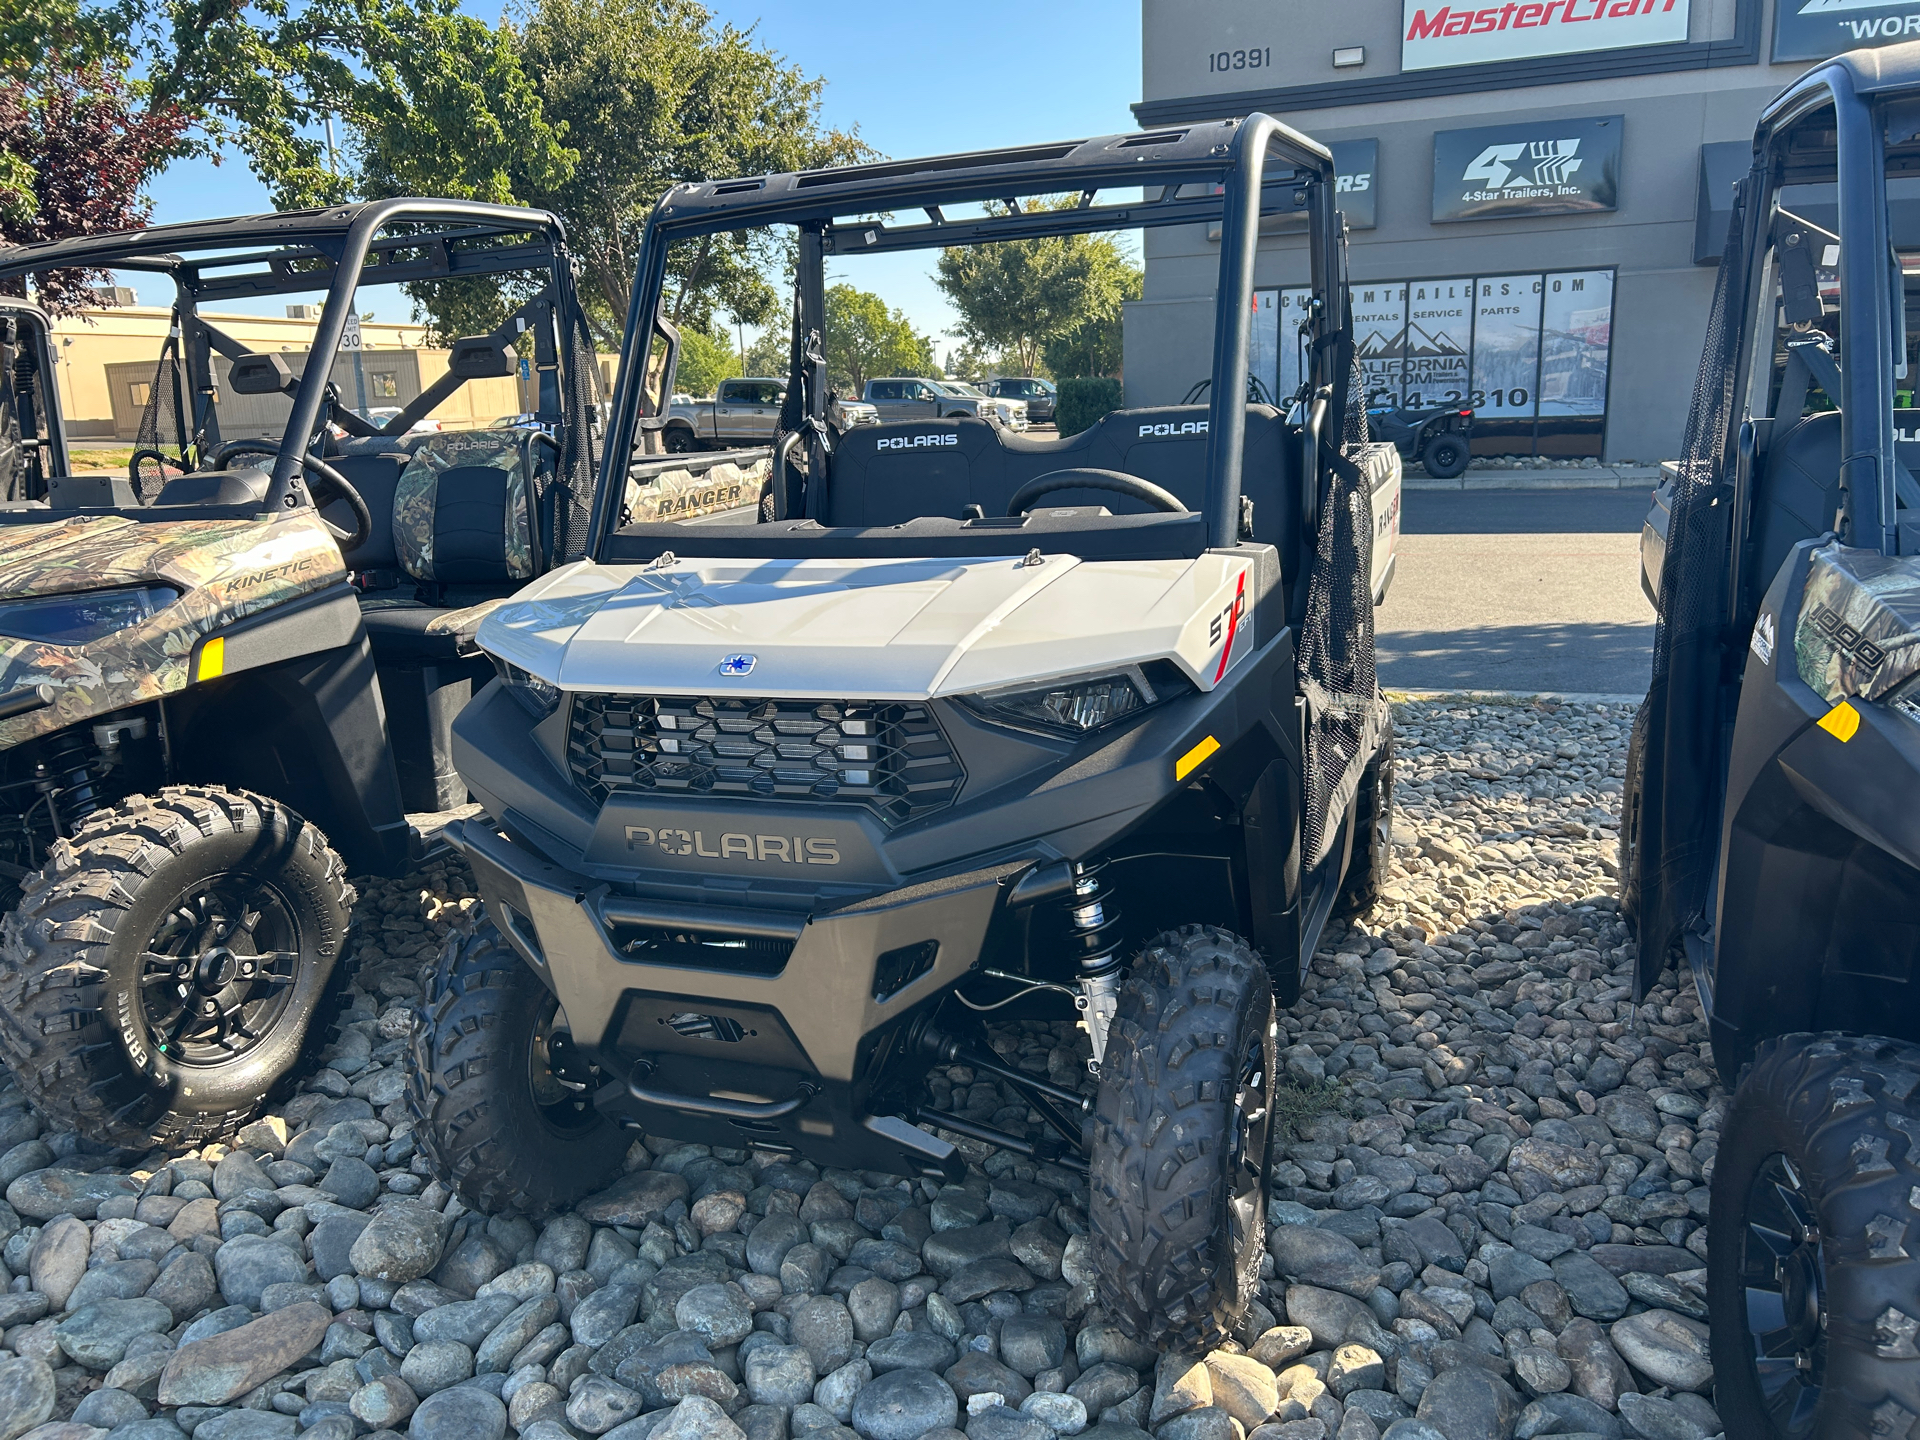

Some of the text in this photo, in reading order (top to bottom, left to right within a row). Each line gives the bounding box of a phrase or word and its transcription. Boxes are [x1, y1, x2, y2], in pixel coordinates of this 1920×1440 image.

[1209, 47, 1270, 72] 10391
[1462, 185, 1581, 202] 4-Star Trailers, Inc.
[1353, 306, 1520, 322] ENTALS SERVICE PARTS
[342, 333, 360, 347] 30
[1360, 358, 1468, 373] ALIFORNIA
[1361, 372, 1433, 386] USTOM
[1138, 420, 1209, 438] POLAR
[446, 440, 500, 452] POLARIS
[877, 434, 958, 450] POLARIS
[657, 484, 742, 518] RANGER
[225, 557, 313, 594] KINETIC
[1209, 588, 1246, 649] 570
[1238, 612, 1252, 633] EFI
[1810, 601, 1888, 672] 1000
[624, 824, 841, 866] POLARIS
